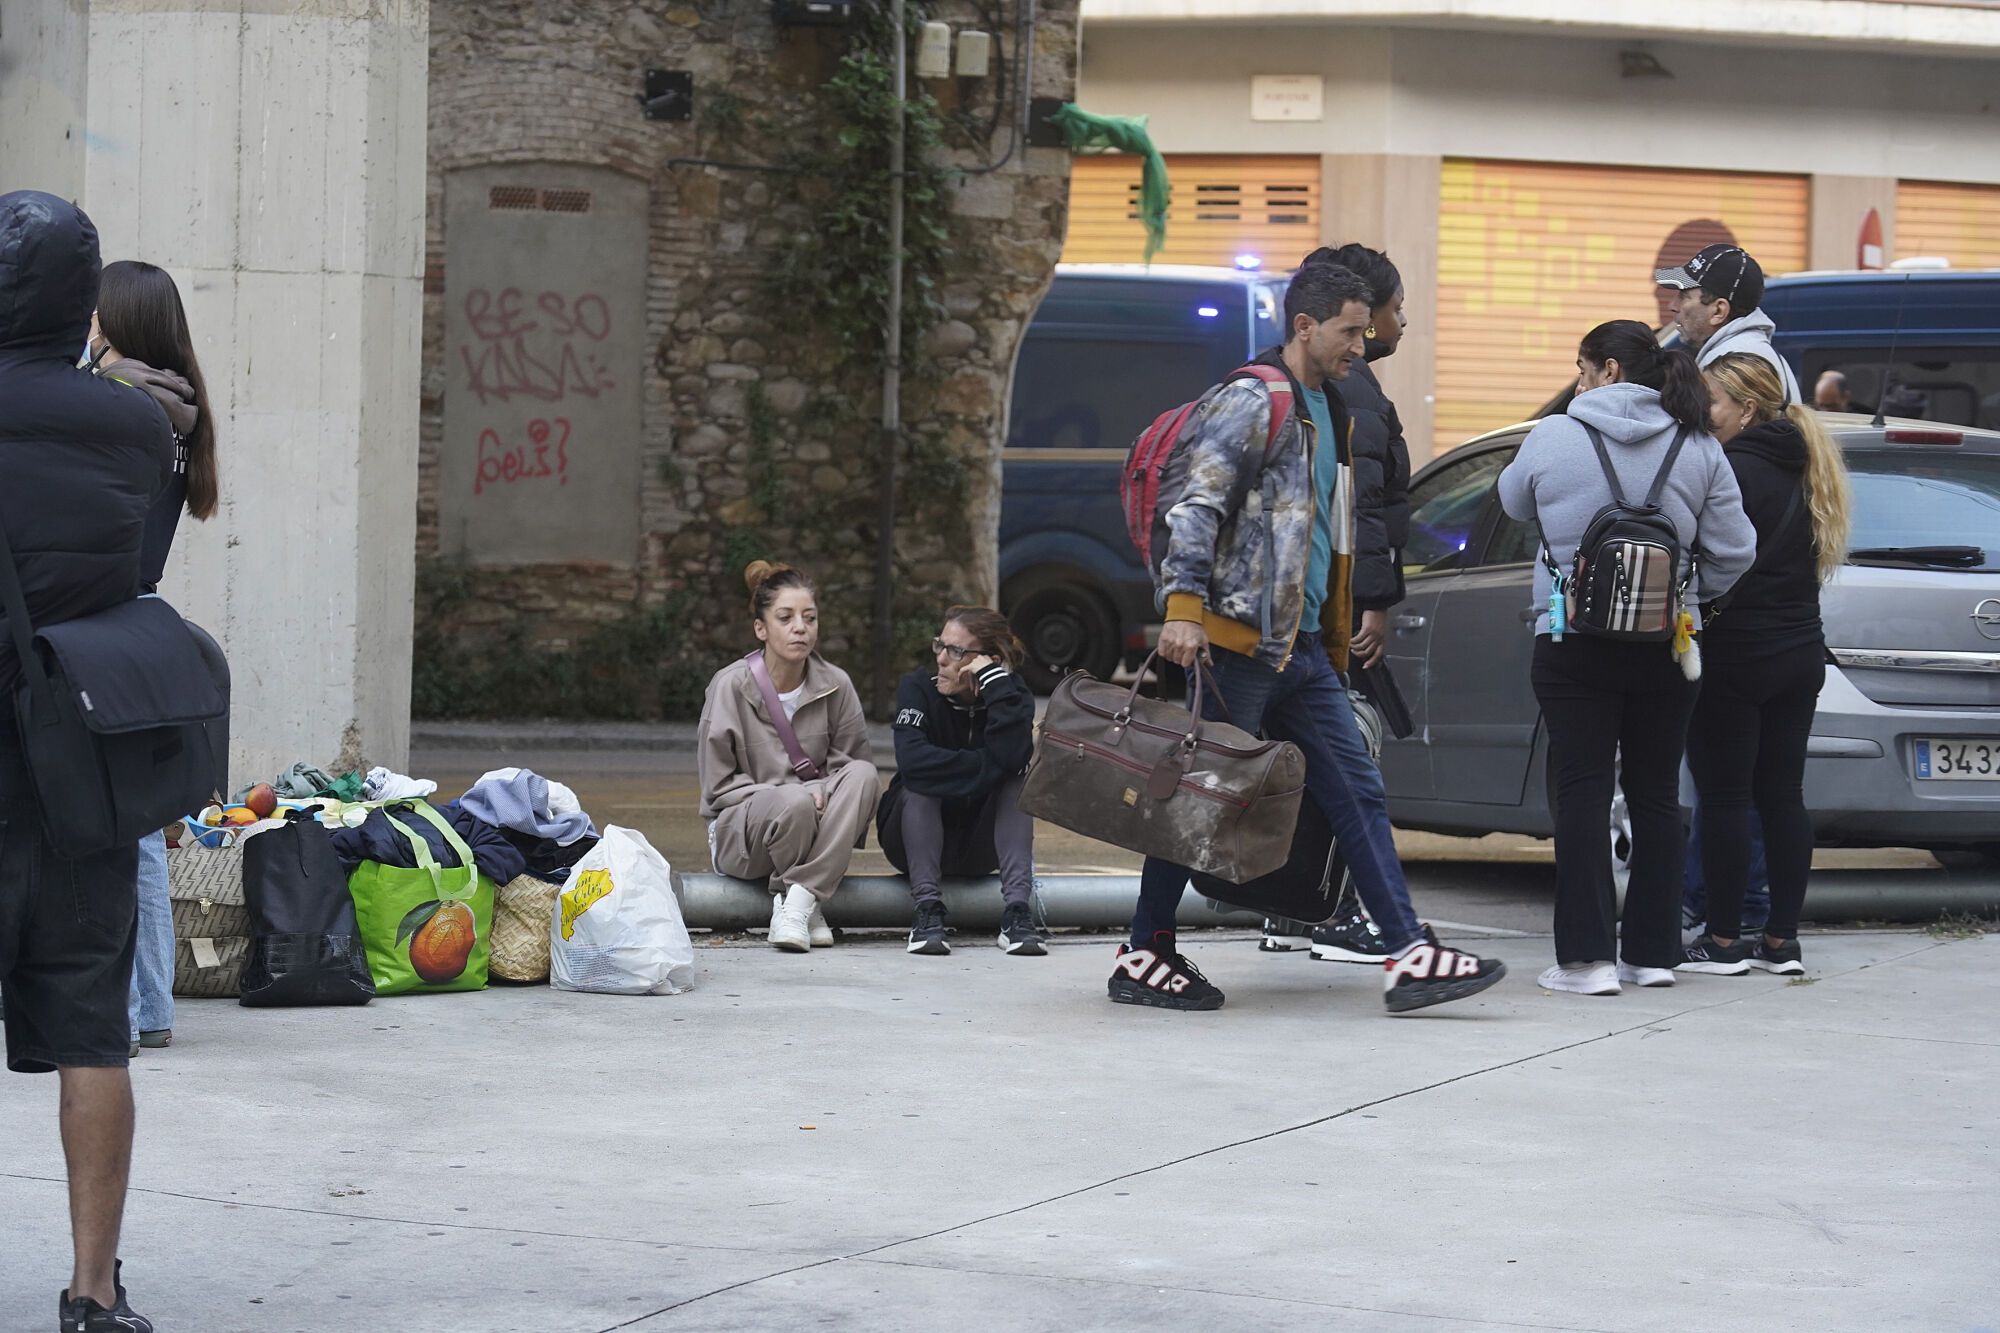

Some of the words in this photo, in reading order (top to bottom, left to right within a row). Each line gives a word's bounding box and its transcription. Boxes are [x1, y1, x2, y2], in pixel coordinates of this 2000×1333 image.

[464, 287, 611, 341] BESO
[1850, 655, 1895, 665] ASTRA
[1111, 949, 1190, 993] AIR
[1385, 945, 1479, 992] AIR
